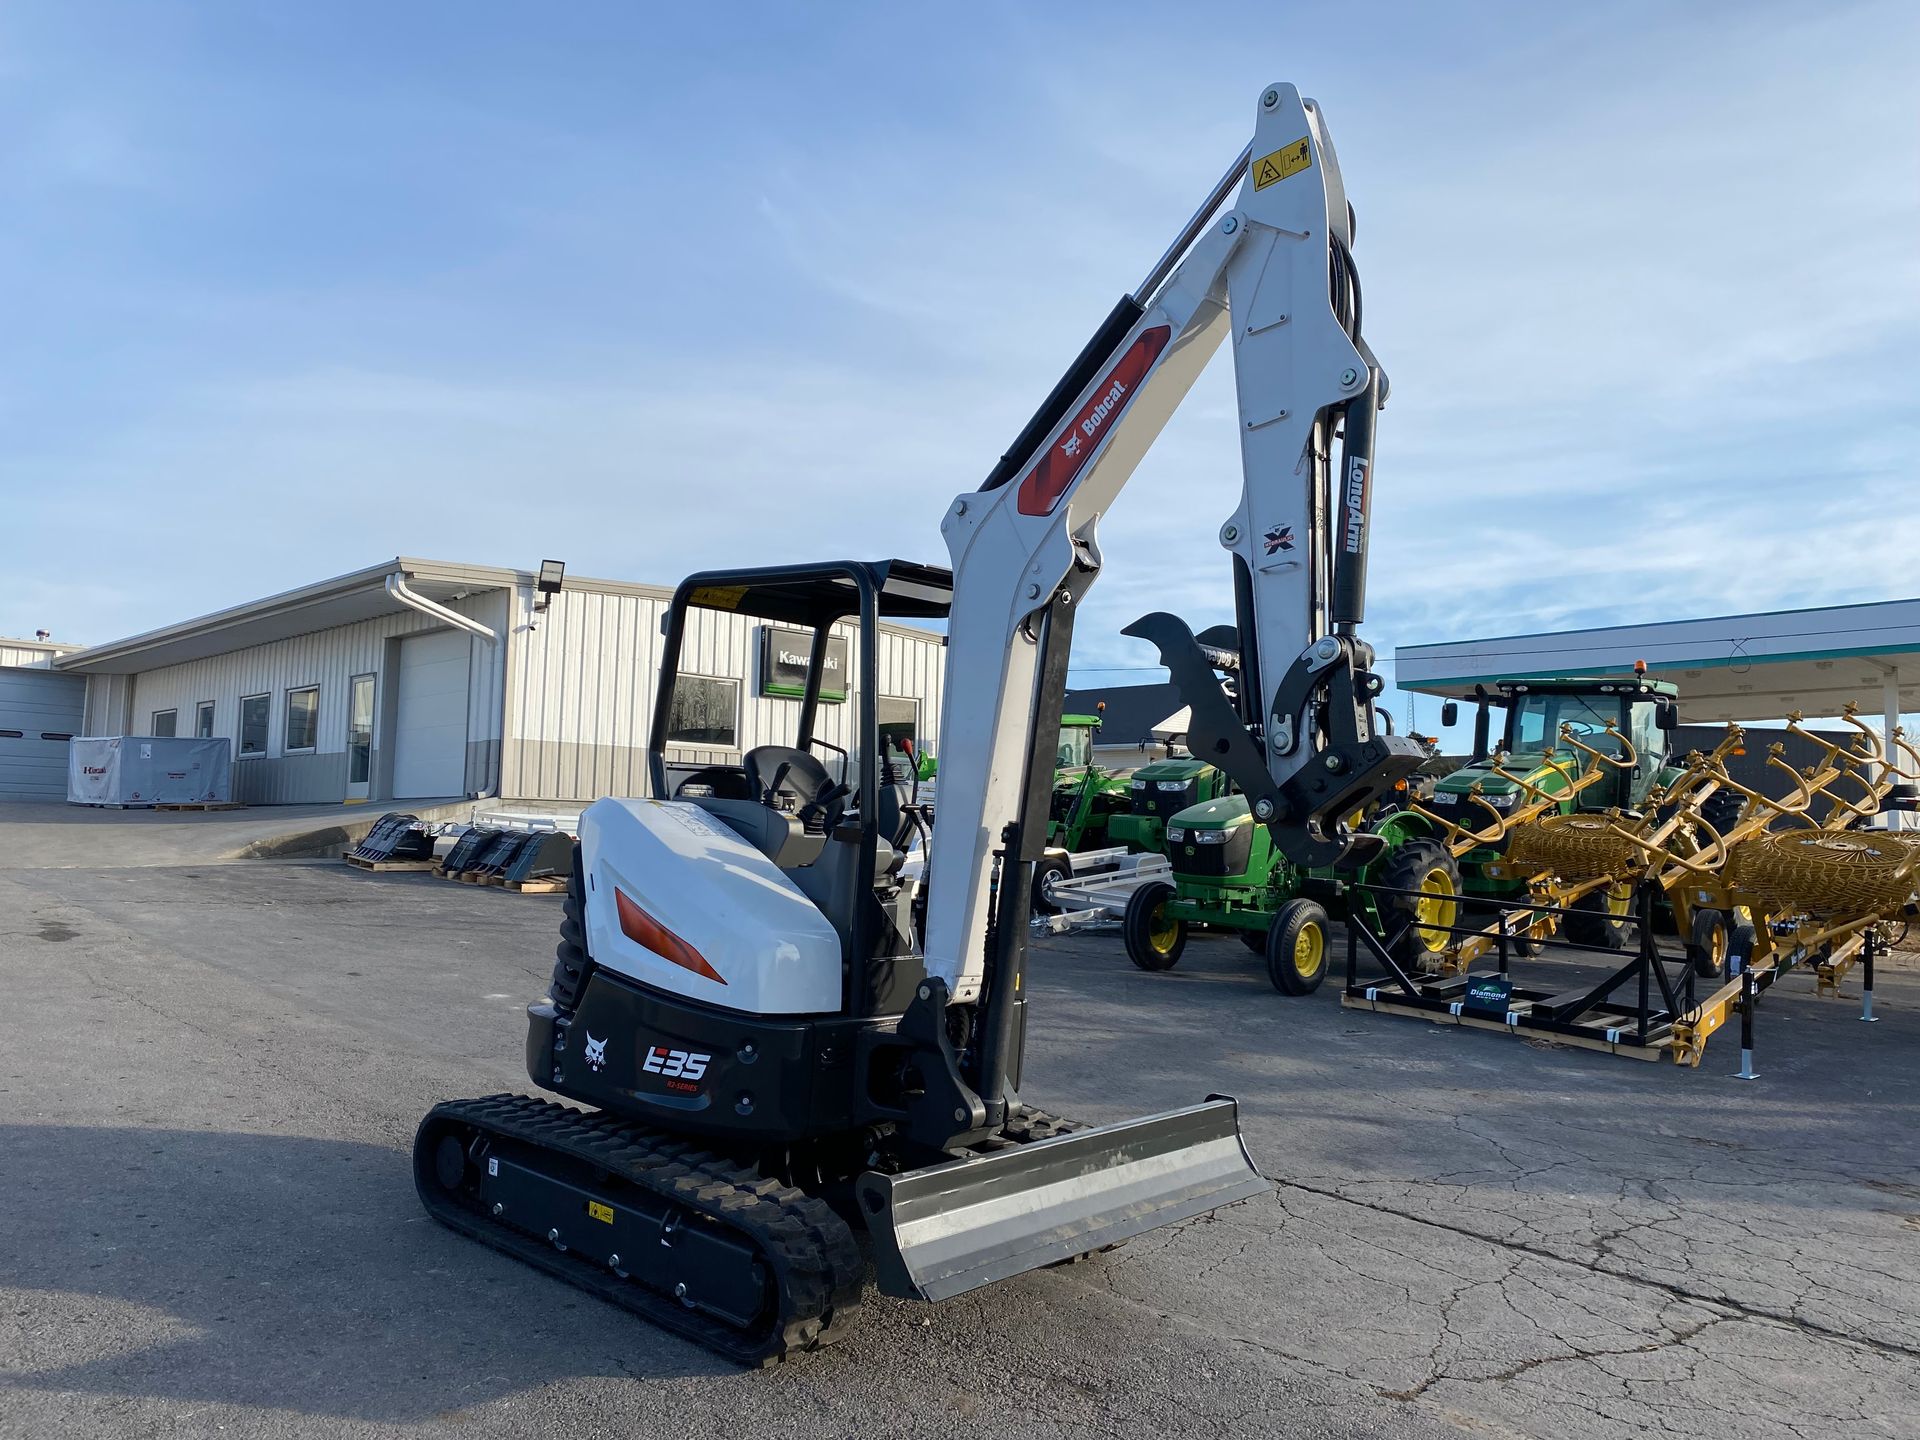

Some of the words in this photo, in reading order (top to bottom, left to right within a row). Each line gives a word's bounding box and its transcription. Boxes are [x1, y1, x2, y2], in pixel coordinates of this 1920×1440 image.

[1081, 380, 1126, 437] Bobcat
[1346, 456, 1369, 553] LongArm
[779, 650, 838, 670] Kawki
[1470, 989, 1507, 999] Diamond
[642, 1046, 711, 1080] E35
